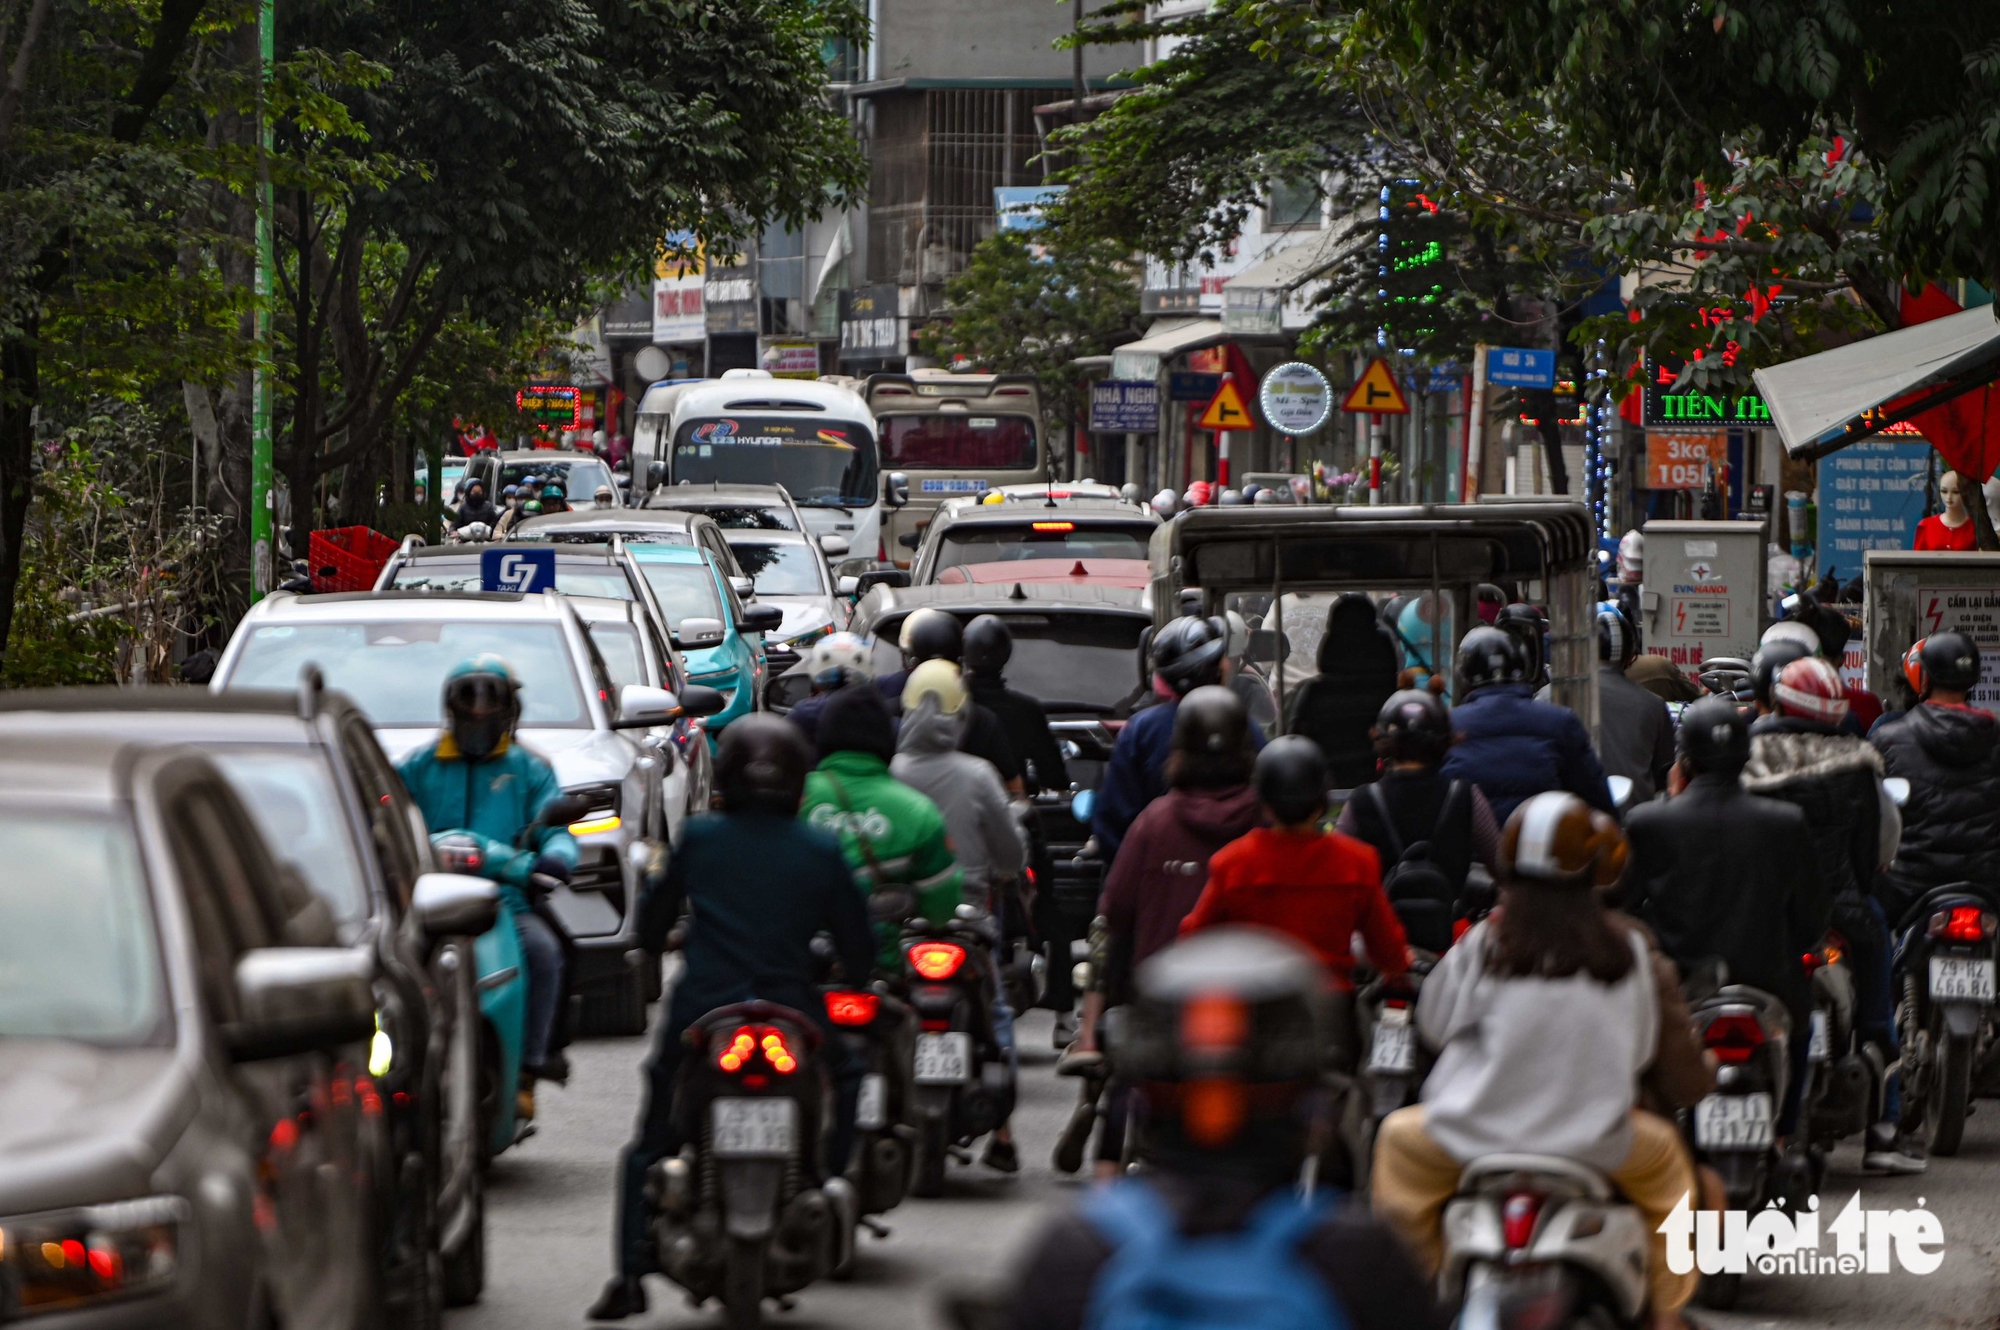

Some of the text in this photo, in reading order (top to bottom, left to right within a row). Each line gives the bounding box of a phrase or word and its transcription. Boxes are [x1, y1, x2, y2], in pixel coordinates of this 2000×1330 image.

[737, 436, 782, 445] HYUNDAI
[1667, 440, 1707, 460] 3kg
[499, 554, 538, 592] G7
[1673, 584, 1729, 594] EVNHANOI
[1947, 594, 1967, 608] CẤM
[1968, 598, 1982, 611] LẠI
[1960, 613, 1971, 622] CÓ
[1671, 643, 1688, 664] GIÁ
[1690, 641, 1703, 664] RẺ
[808, 803, 889, 835] Grab
